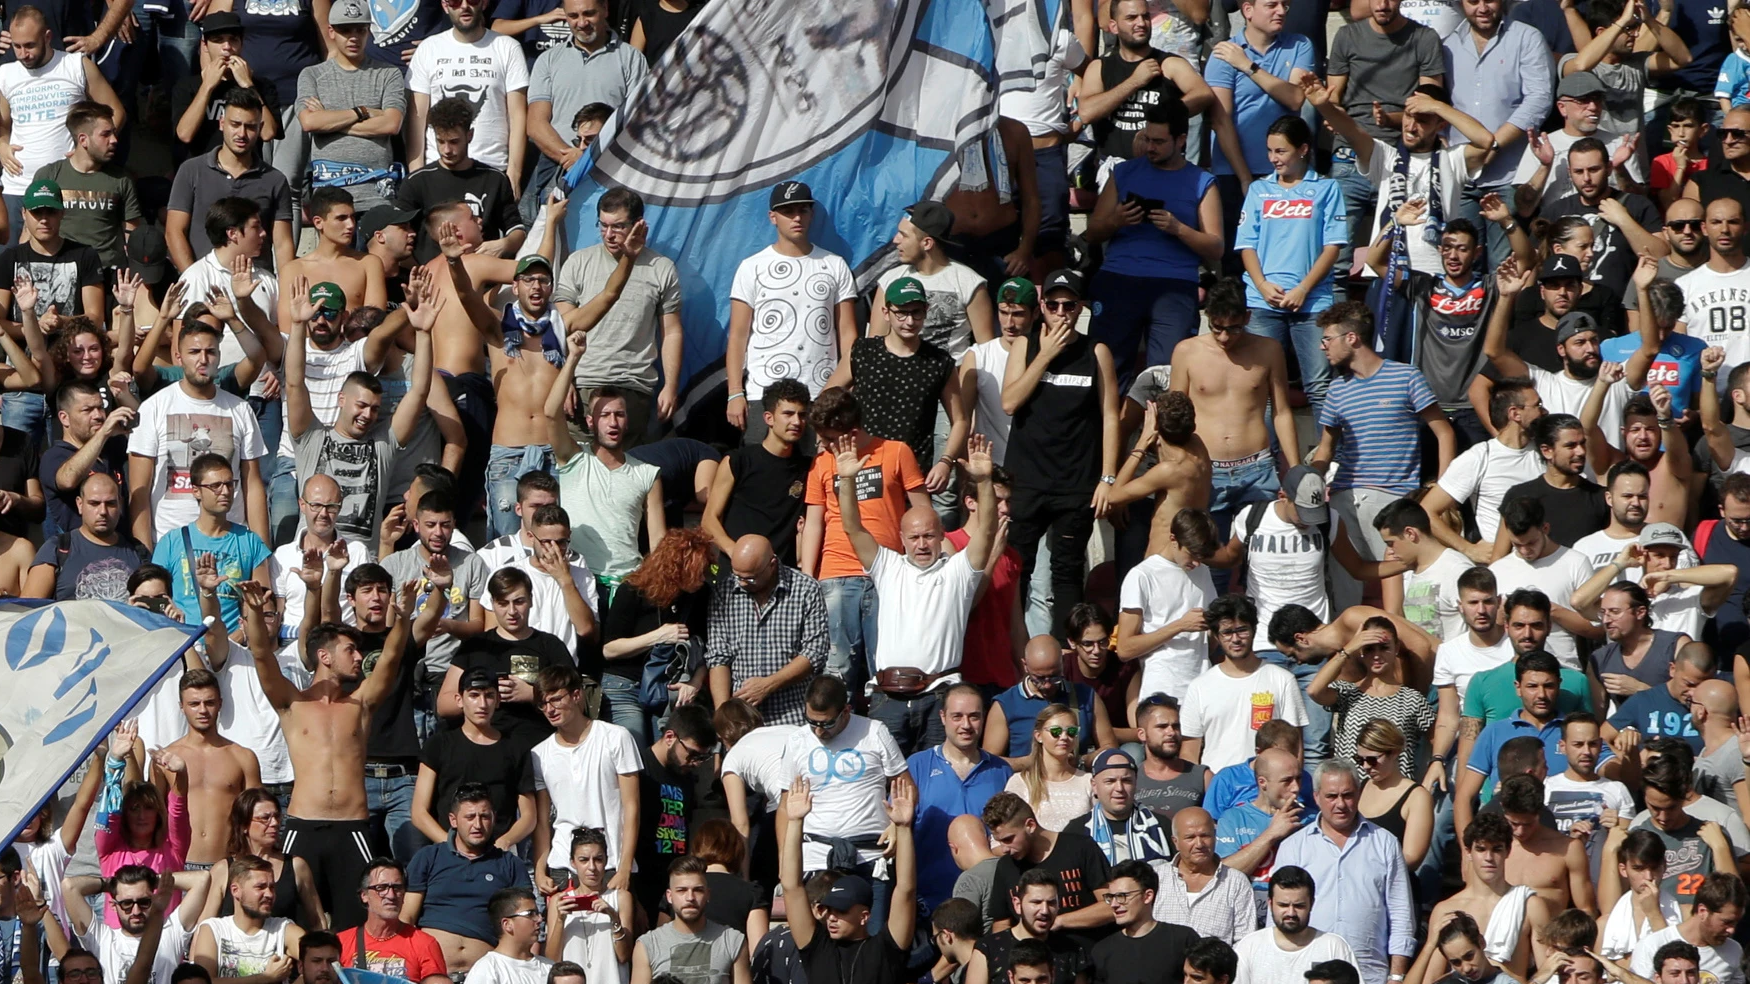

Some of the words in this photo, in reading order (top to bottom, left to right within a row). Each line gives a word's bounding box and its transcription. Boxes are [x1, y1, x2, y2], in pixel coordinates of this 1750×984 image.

[378, 16, 419, 48] azzurro
[62, 199, 113, 210] MPROVE
[1263, 200, 1312, 218] Lete
[1693, 288, 1750, 313] ARKANS
[1710, 306, 1745, 332] 08
[1450, 326, 1475, 337] MSC
[1646, 365, 1679, 381] ete
[1250, 533, 1322, 553] MALIBU
[1647, 711, 1699, 737] 192
[808, 746, 866, 791] 90
[660, 784, 682, 801] AMS
[661, 798, 682, 817] TER
[655, 827, 685, 842] SINCE
[1676, 873, 1706, 895] 22
